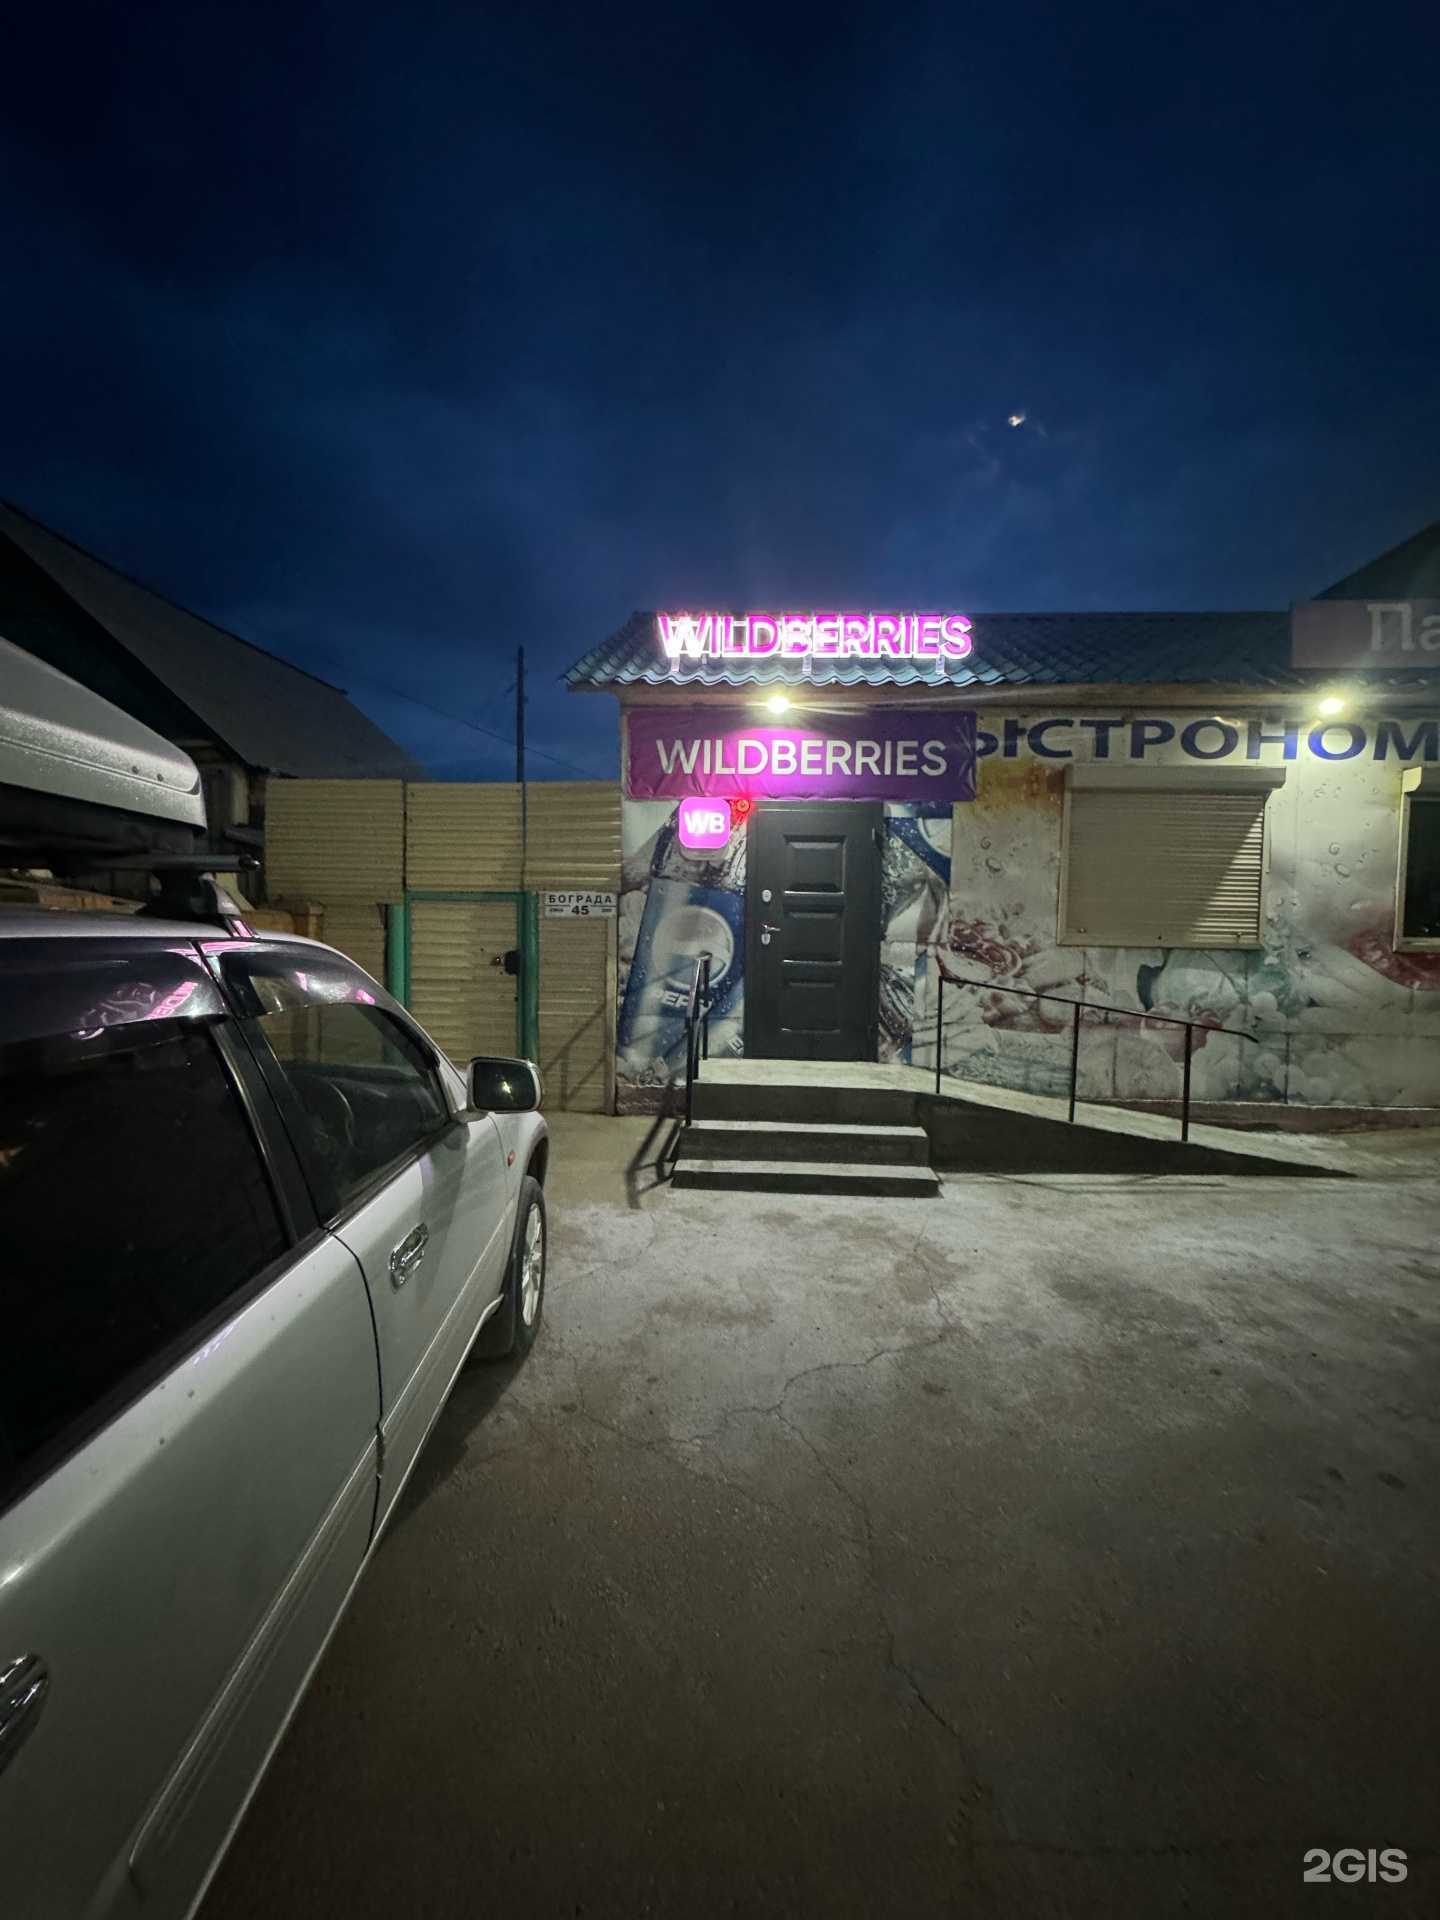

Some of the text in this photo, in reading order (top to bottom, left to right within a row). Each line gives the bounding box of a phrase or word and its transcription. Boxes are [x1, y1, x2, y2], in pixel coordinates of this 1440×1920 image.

[657, 614, 973, 659] WILDBERRIES
[656, 739, 947, 776] WILDBERRIES
[684, 812, 725, 834] WB
[549, 894, 612, 904] БОГРАДА
[571, 905, 590, 915] 45
